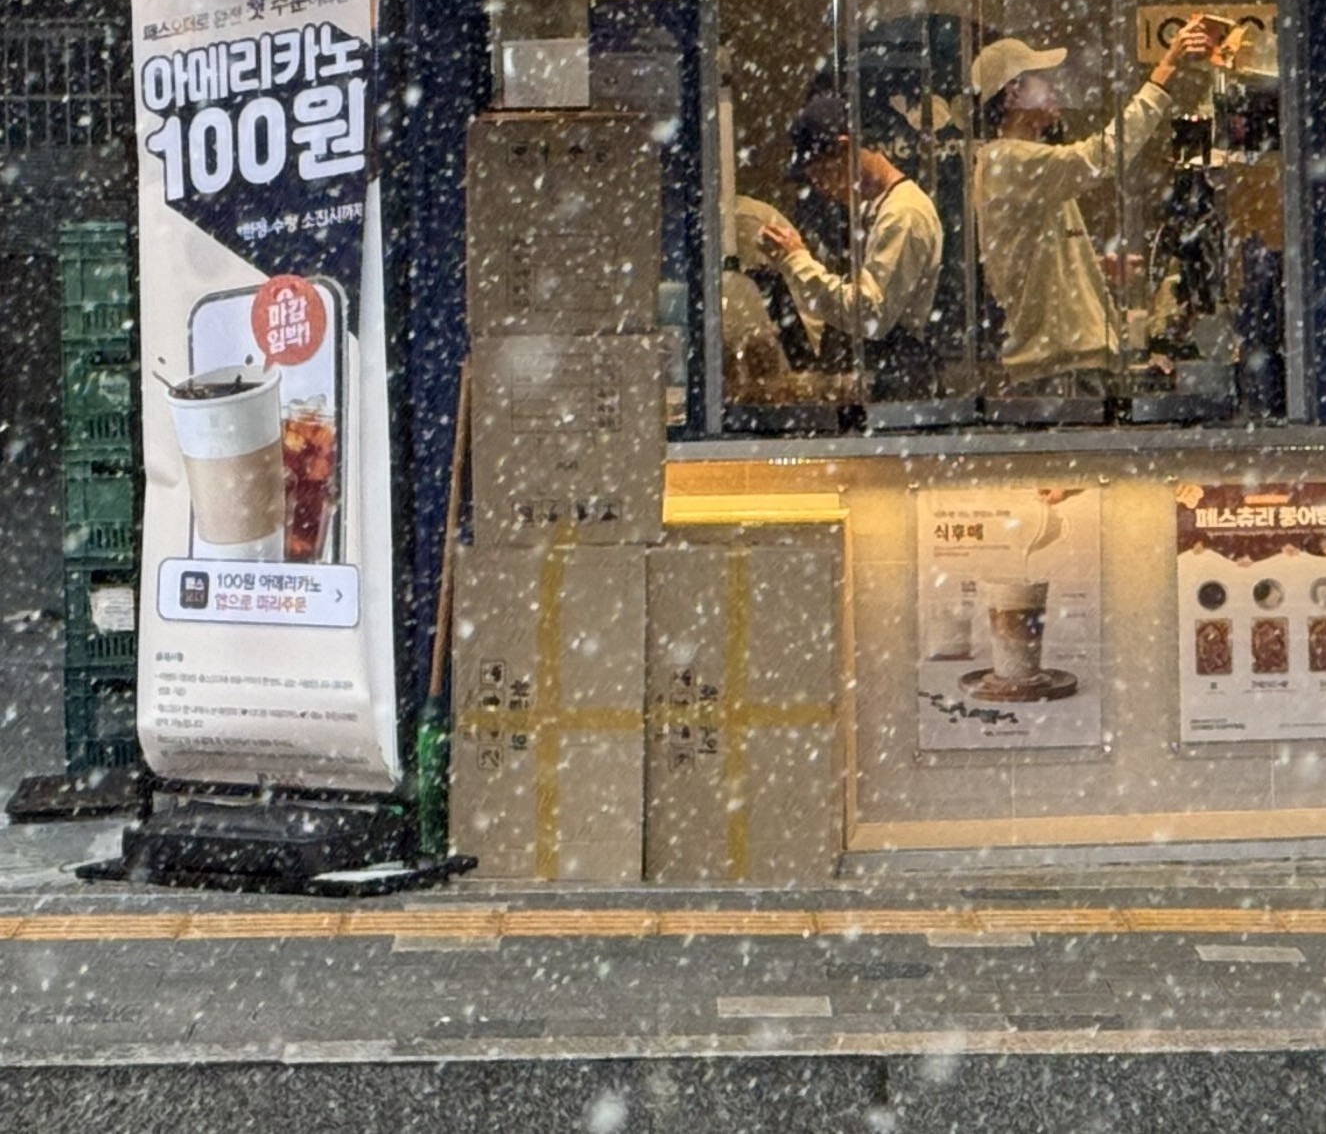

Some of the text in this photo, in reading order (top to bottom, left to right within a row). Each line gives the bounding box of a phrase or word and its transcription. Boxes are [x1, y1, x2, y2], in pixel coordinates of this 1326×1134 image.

[143, 21, 364, 112] 아메리카노
[147, 77, 366, 201] 100원
[267, 295, 308, 327] 마감
[1195, 506, 1275, 528] 페스츄리
[217, 573, 323, 593] 100원 아메리카노
